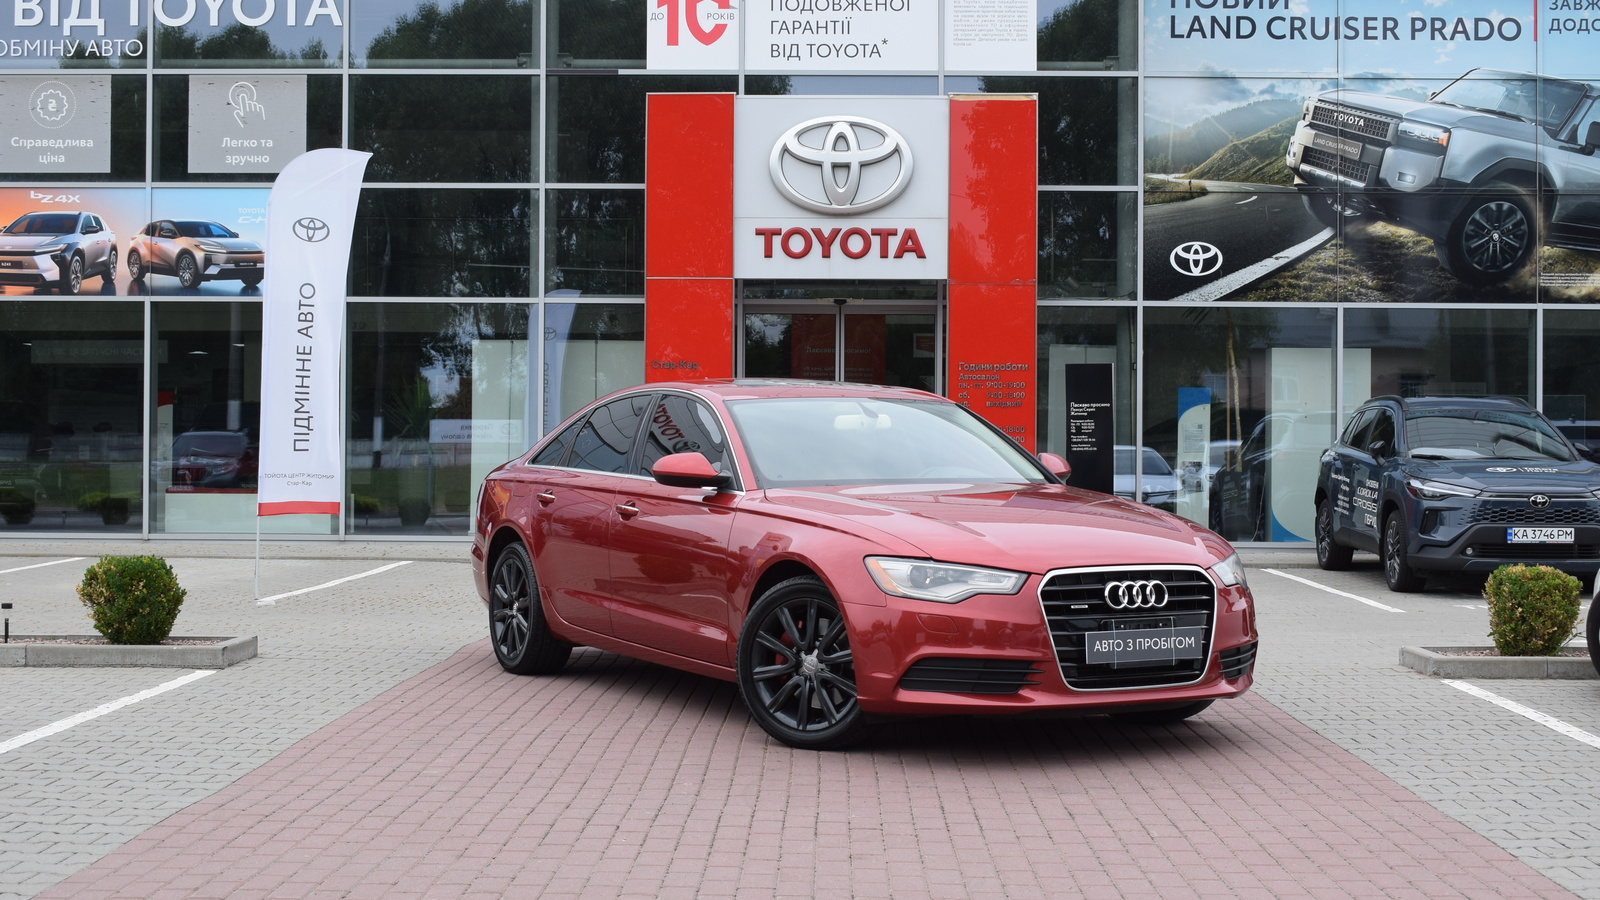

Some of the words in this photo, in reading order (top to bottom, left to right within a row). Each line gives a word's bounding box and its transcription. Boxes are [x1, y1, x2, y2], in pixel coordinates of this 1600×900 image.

[14, 0, 105, 36] ВІД
[650, 12, 664, 21] ДО
[706, 12, 735, 20] РОКІВ
[770, 17, 851, 35] ГАРАНТІЇ
[1170, 15, 1256, 39] LAND
[1266, 16, 1400, 41] CRUISER
[1410, 17, 1522, 42] PRADO
[85, 40, 142, 57] АВТО
[770, 43, 801, 60] ВІД
[1334, 112, 1364, 126] TOYOTA
[10, 137, 94, 149] Справедлива
[222, 137, 257, 148] Легко
[258, 139, 273, 148] та
[39, 154, 66, 164] ціна
[225, 154, 270, 165] зручно
[756, 227, 926, 259] TOYOTA
[298, 282, 316, 339] АВТО
[652, 360, 699, 370] Стар-Кар
[958, 362, 992, 372] Години
[994, 362, 1029, 372] роботи
[294, 345, 314, 452] ПІДМІННЕ
[1353, 497, 1377, 512] CROSS
[1513, 529, 1529, 539] KA
[1531, 529, 1555, 539] 3746
[1557, 529, 1573, 539] PM
[1094, 639, 1124, 652] АВТО
[1136, 636, 1195, 650] ПРОБІГОМ
